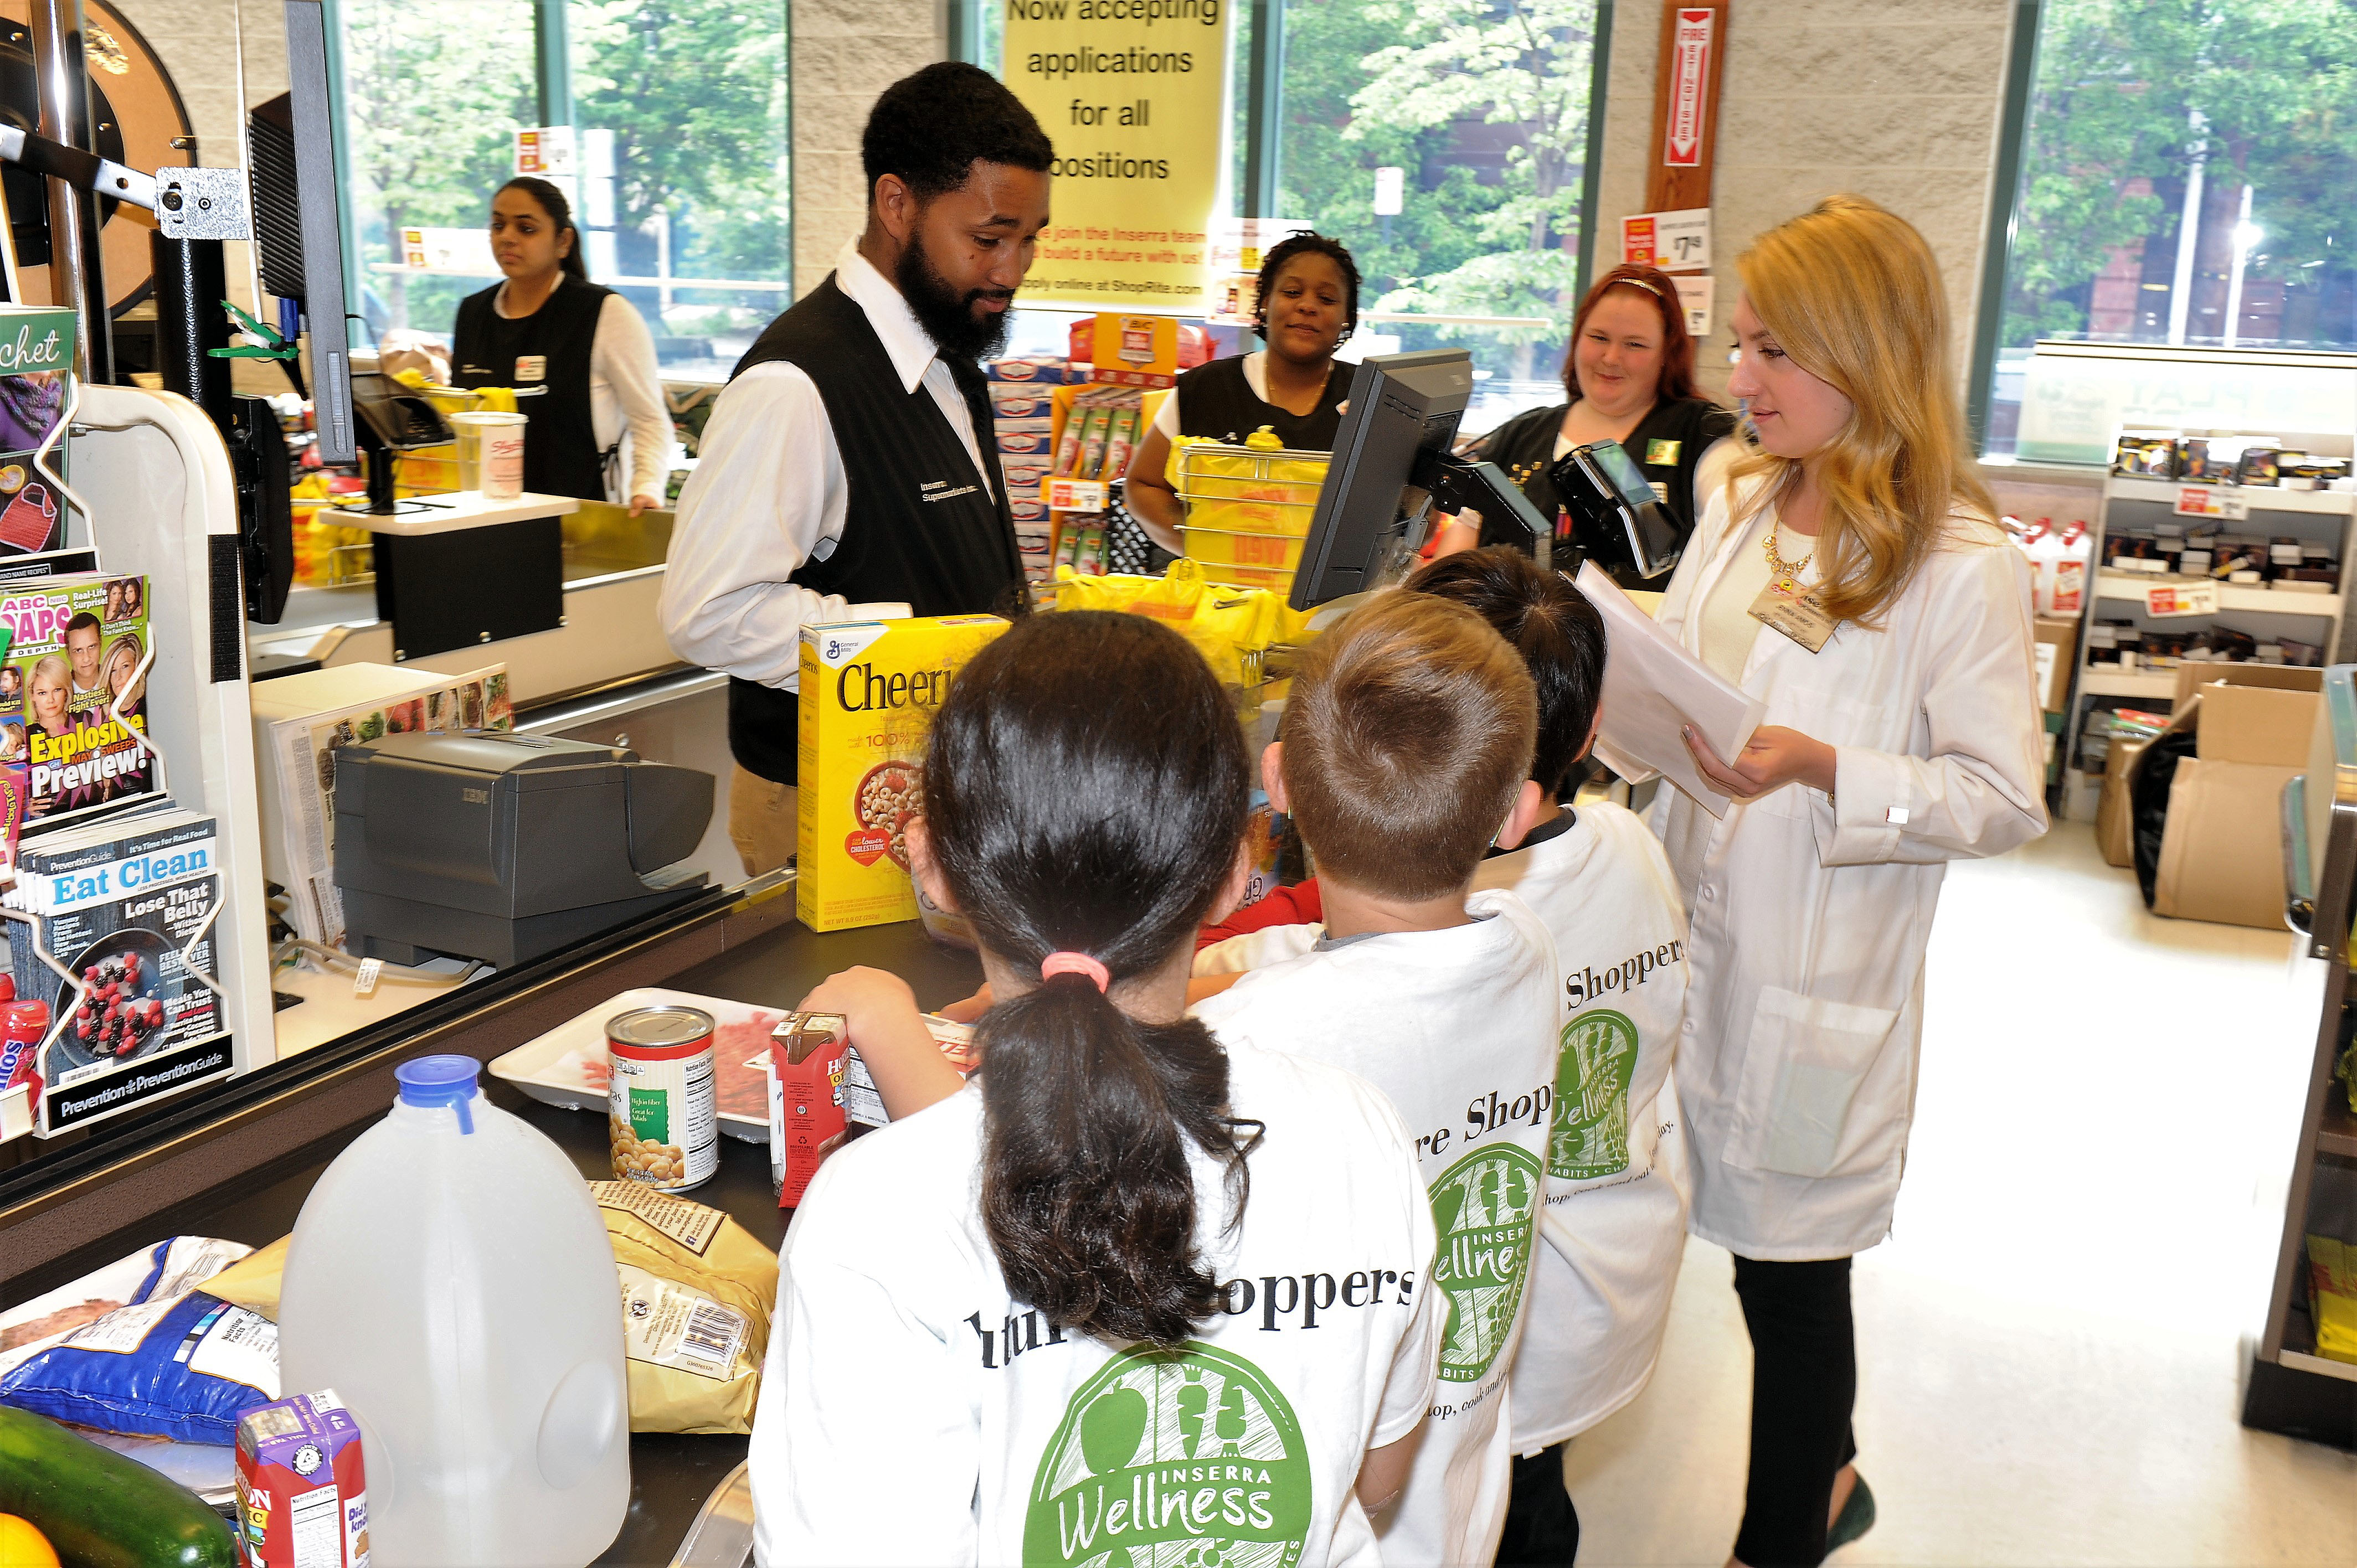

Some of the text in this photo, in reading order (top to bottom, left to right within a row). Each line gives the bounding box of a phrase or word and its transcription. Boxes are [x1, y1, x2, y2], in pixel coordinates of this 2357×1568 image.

[1008, 0, 1219, 26] Now accepting
[1681, 28, 1707, 41] FIRE
[1027, 46, 1194, 79] applications
[1069, 99, 1151, 126] for all
[1053, 226, 1082, 244] join
[1085, 226, 1108, 241] the
[1113, 226, 1169, 244] Inserra
[1172, 229, 1206, 245] team
[1044, 246, 1080, 260] build
[1084, 250, 1093, 261] a
[1097, 248, 1142, 263] future
[1146, 249, 1177, 264] with
[1022, 277, 1202, 296] pply online at ShopRite.com
[2, 597, 45, 611] ABC
[73, 588, 108, 602] Real-Life
[73, 595, 108, 610] Surprise!
[18, 645, 58, 656] DEPTH
[837, 657, 953, 712] Cheeri
[68, 694, 110, 714] Fight Ever!
[73, 688, 106, 703] Nastiest
[30, 714, 145, 765] Explosive
[866, 733, 910, 747] 100%
[71, 738, 137, 765] MAY SWEEPS
[31, 741, 147, 798] Preview!
[129, 843, 142, 854] It's
[143, 840, 161, 851] Time
[160, 837, 172, 848] for
[172, 833, 191, 844] Real
[191, 828, 208, 840] Food
[52, 849, 208, 905] Eat Clean
[125, 882, 209, 920] Lose That
[164, 899, 209, 924] Belly
[166, 916, 205, 932] —Withou
[159, 949, 182, 963] FEEL
[192, 987, 212, 999] You
[167, 995, 213, 1016] Can Trust
[1588, 1058, 1619, 1091] INSERRA
[61, 1085, 126, 1117] Prevention
[136, 1053, 223, 1092] PreventionGuide
[631, 1097, 641, 1107] High
[1542, 1192, 1571, 1206] hop,
[1220, 1268, 1415, 1332] oppers
[222, 1318, 244, 1340] Nutrition
[229, 1327, 246, 1343] Facts
[1439, 1363, 1475, 1380] BITS
[1161, 1466, 1272, 1485] INSERRA
[292, 1487, 336, 1504] Nutrition Facts
[349, 1503, 363, 1521] Did
[1058, 1472, 1274, 1561] Wellness
